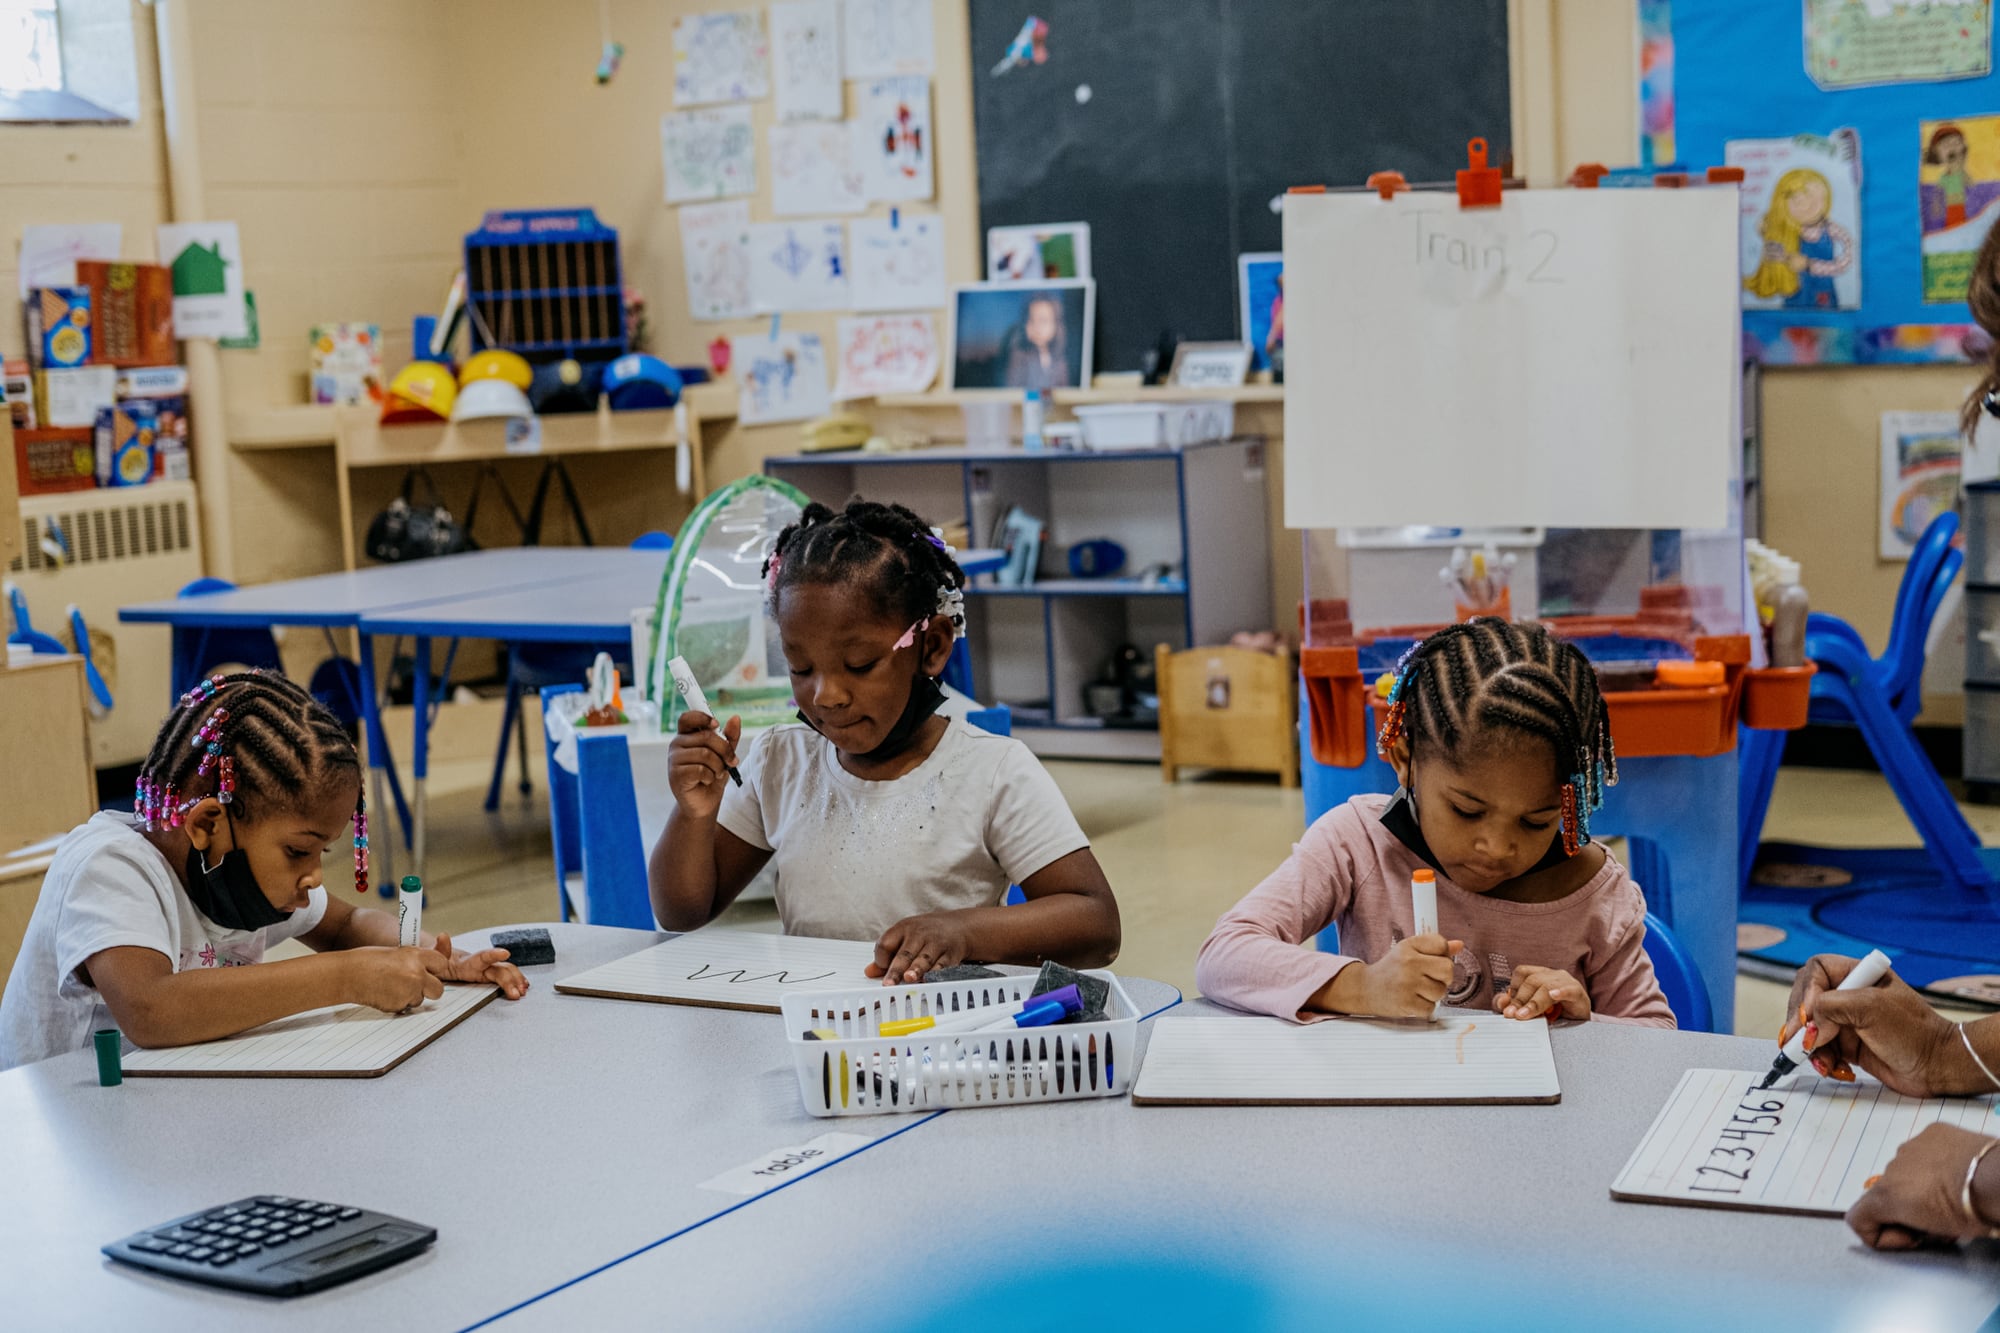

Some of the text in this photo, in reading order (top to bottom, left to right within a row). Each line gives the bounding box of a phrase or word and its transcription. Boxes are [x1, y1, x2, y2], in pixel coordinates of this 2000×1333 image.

[1400, 209, 1565, 283] Train 2
[752, 1149, 825, 1176] table
